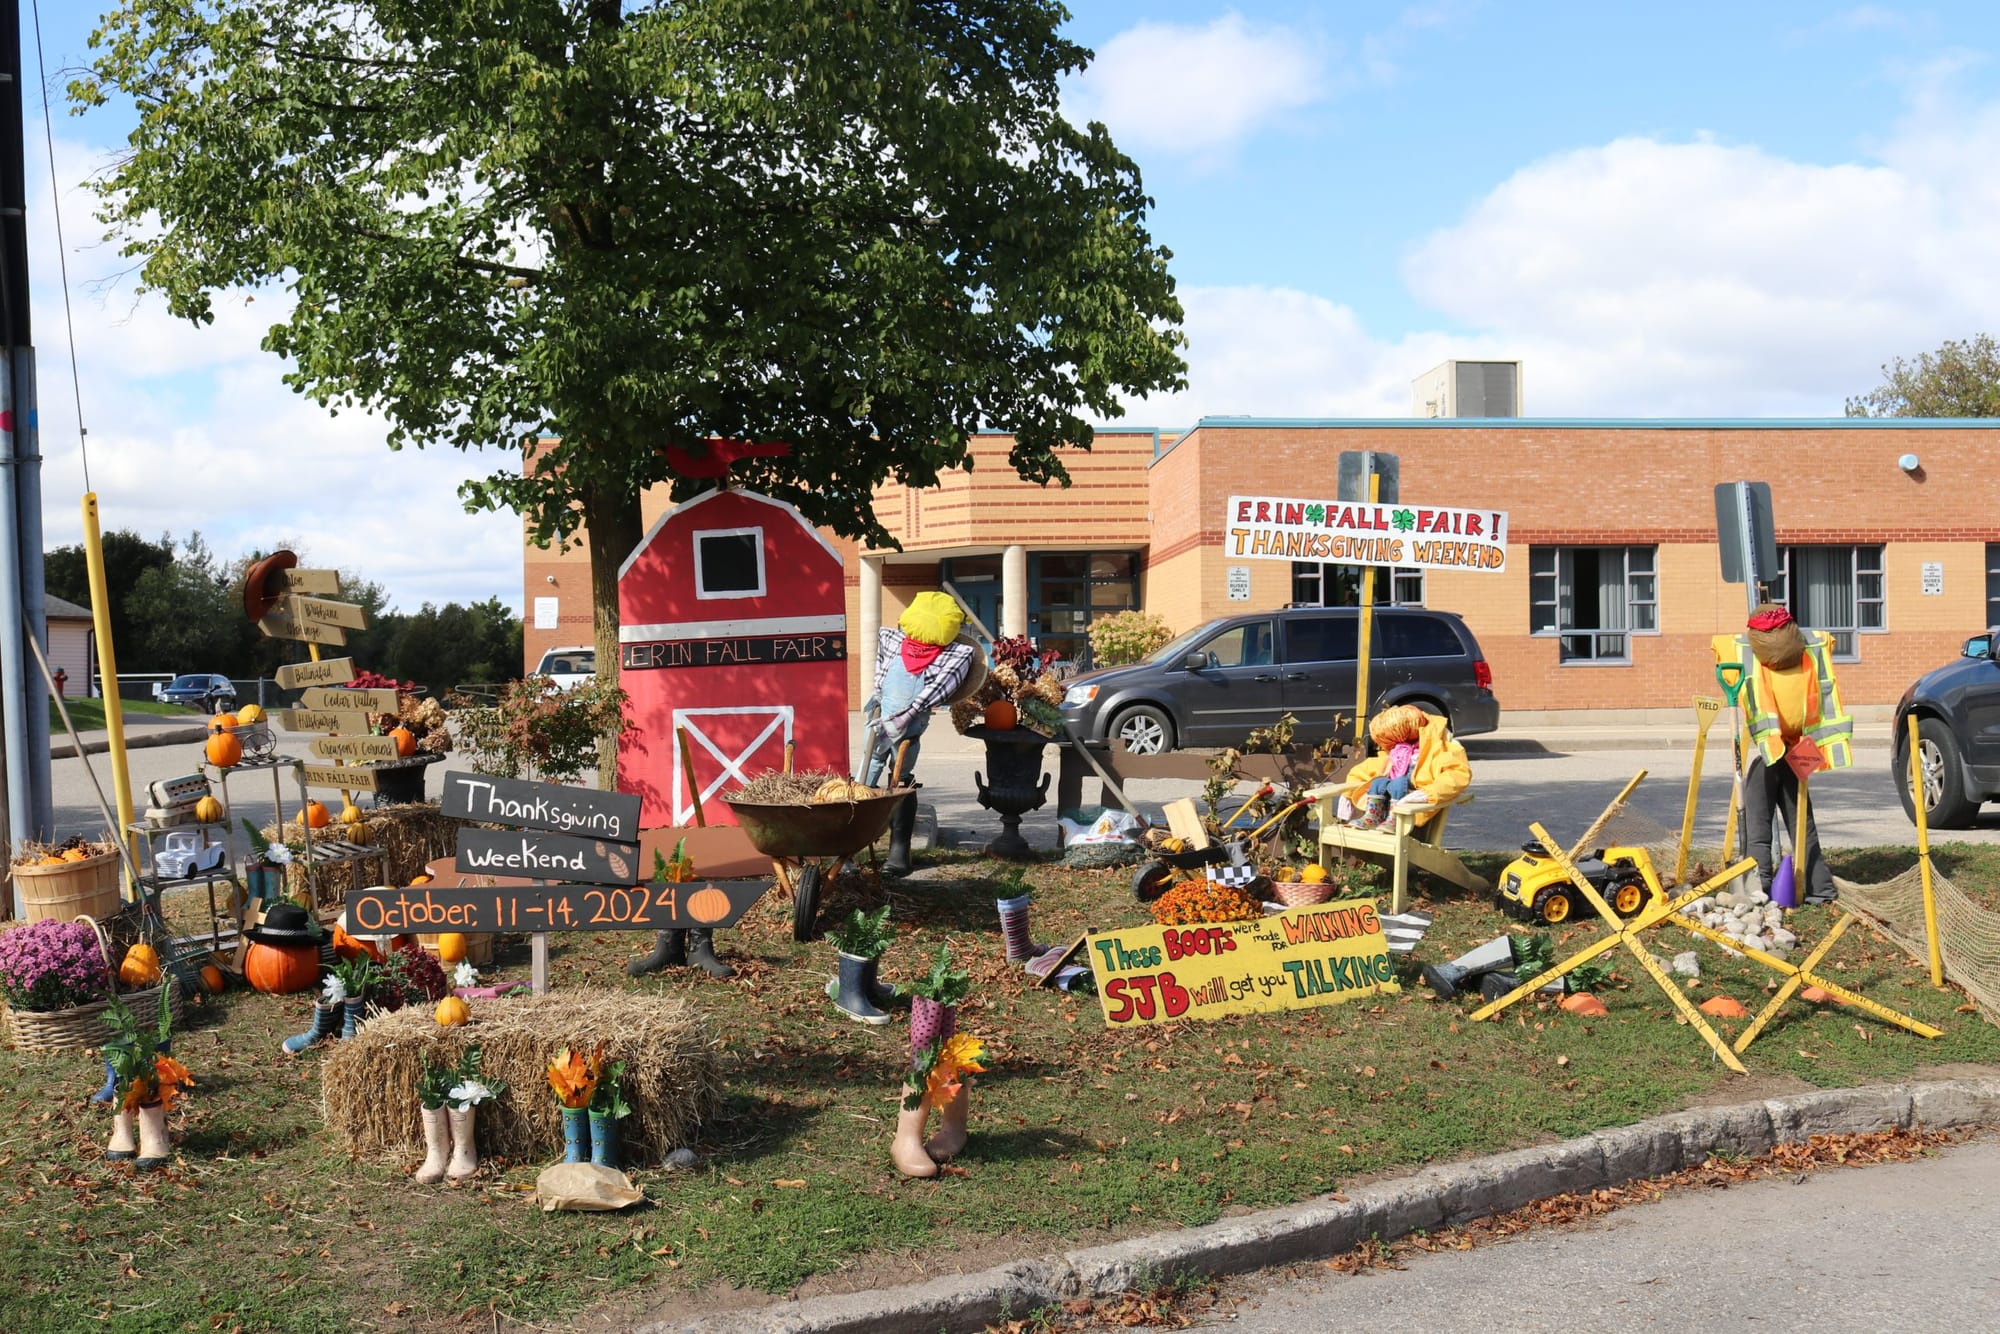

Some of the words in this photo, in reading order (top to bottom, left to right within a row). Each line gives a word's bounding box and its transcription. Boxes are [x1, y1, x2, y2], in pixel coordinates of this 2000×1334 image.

[1237, 501, 1306, 525] ERIN
[1324, 505, 1389, 531] FALL
[1231, 528, 1404, 563] THANKSGIVING
[1413, 540, 1505, 569] WEEKEND
[630, 642, 692, 667] ERIN
[705, 639, 762, 664] FALL
[773, 636, 826, 660] FAIR
[323, 693, 351, 709] Cedar
[353, 690, 379, 712] Valley
[1697, 701, 1719, 711] YIELD
[361, 742, 392, 756] Corners
[304, 771, 324, 783] RIN
[326, 773, 349, 784] FALL
[349, 774, 371, 786] FAIR
[455, 778, 621, 838] Thanksgiving
[1540, 835, 1588, 887] CAUTION
[584, 887, 677, 924] 2024
[1095, 938, 1162, 972] These
[1232, 921, 1261, 936] were
[1252, 931, 1280, 943] made
[1272, 940, 1288, 952] FOR
[1280, 904, 1381, 945] WALKING
[1105, 972, 1190, 1023] SJB
[1189, 976, 1229, 1006] will
[1230, 973, 1254, 1001] get
[1258, 974, 1288, 997] you
[1282, 951, 1400, 999] TALKING!
[1628, 940, 1706, 1029] CONSTRUCTION
[1808, 974, 1902, 1021] CONSTRUCTION
